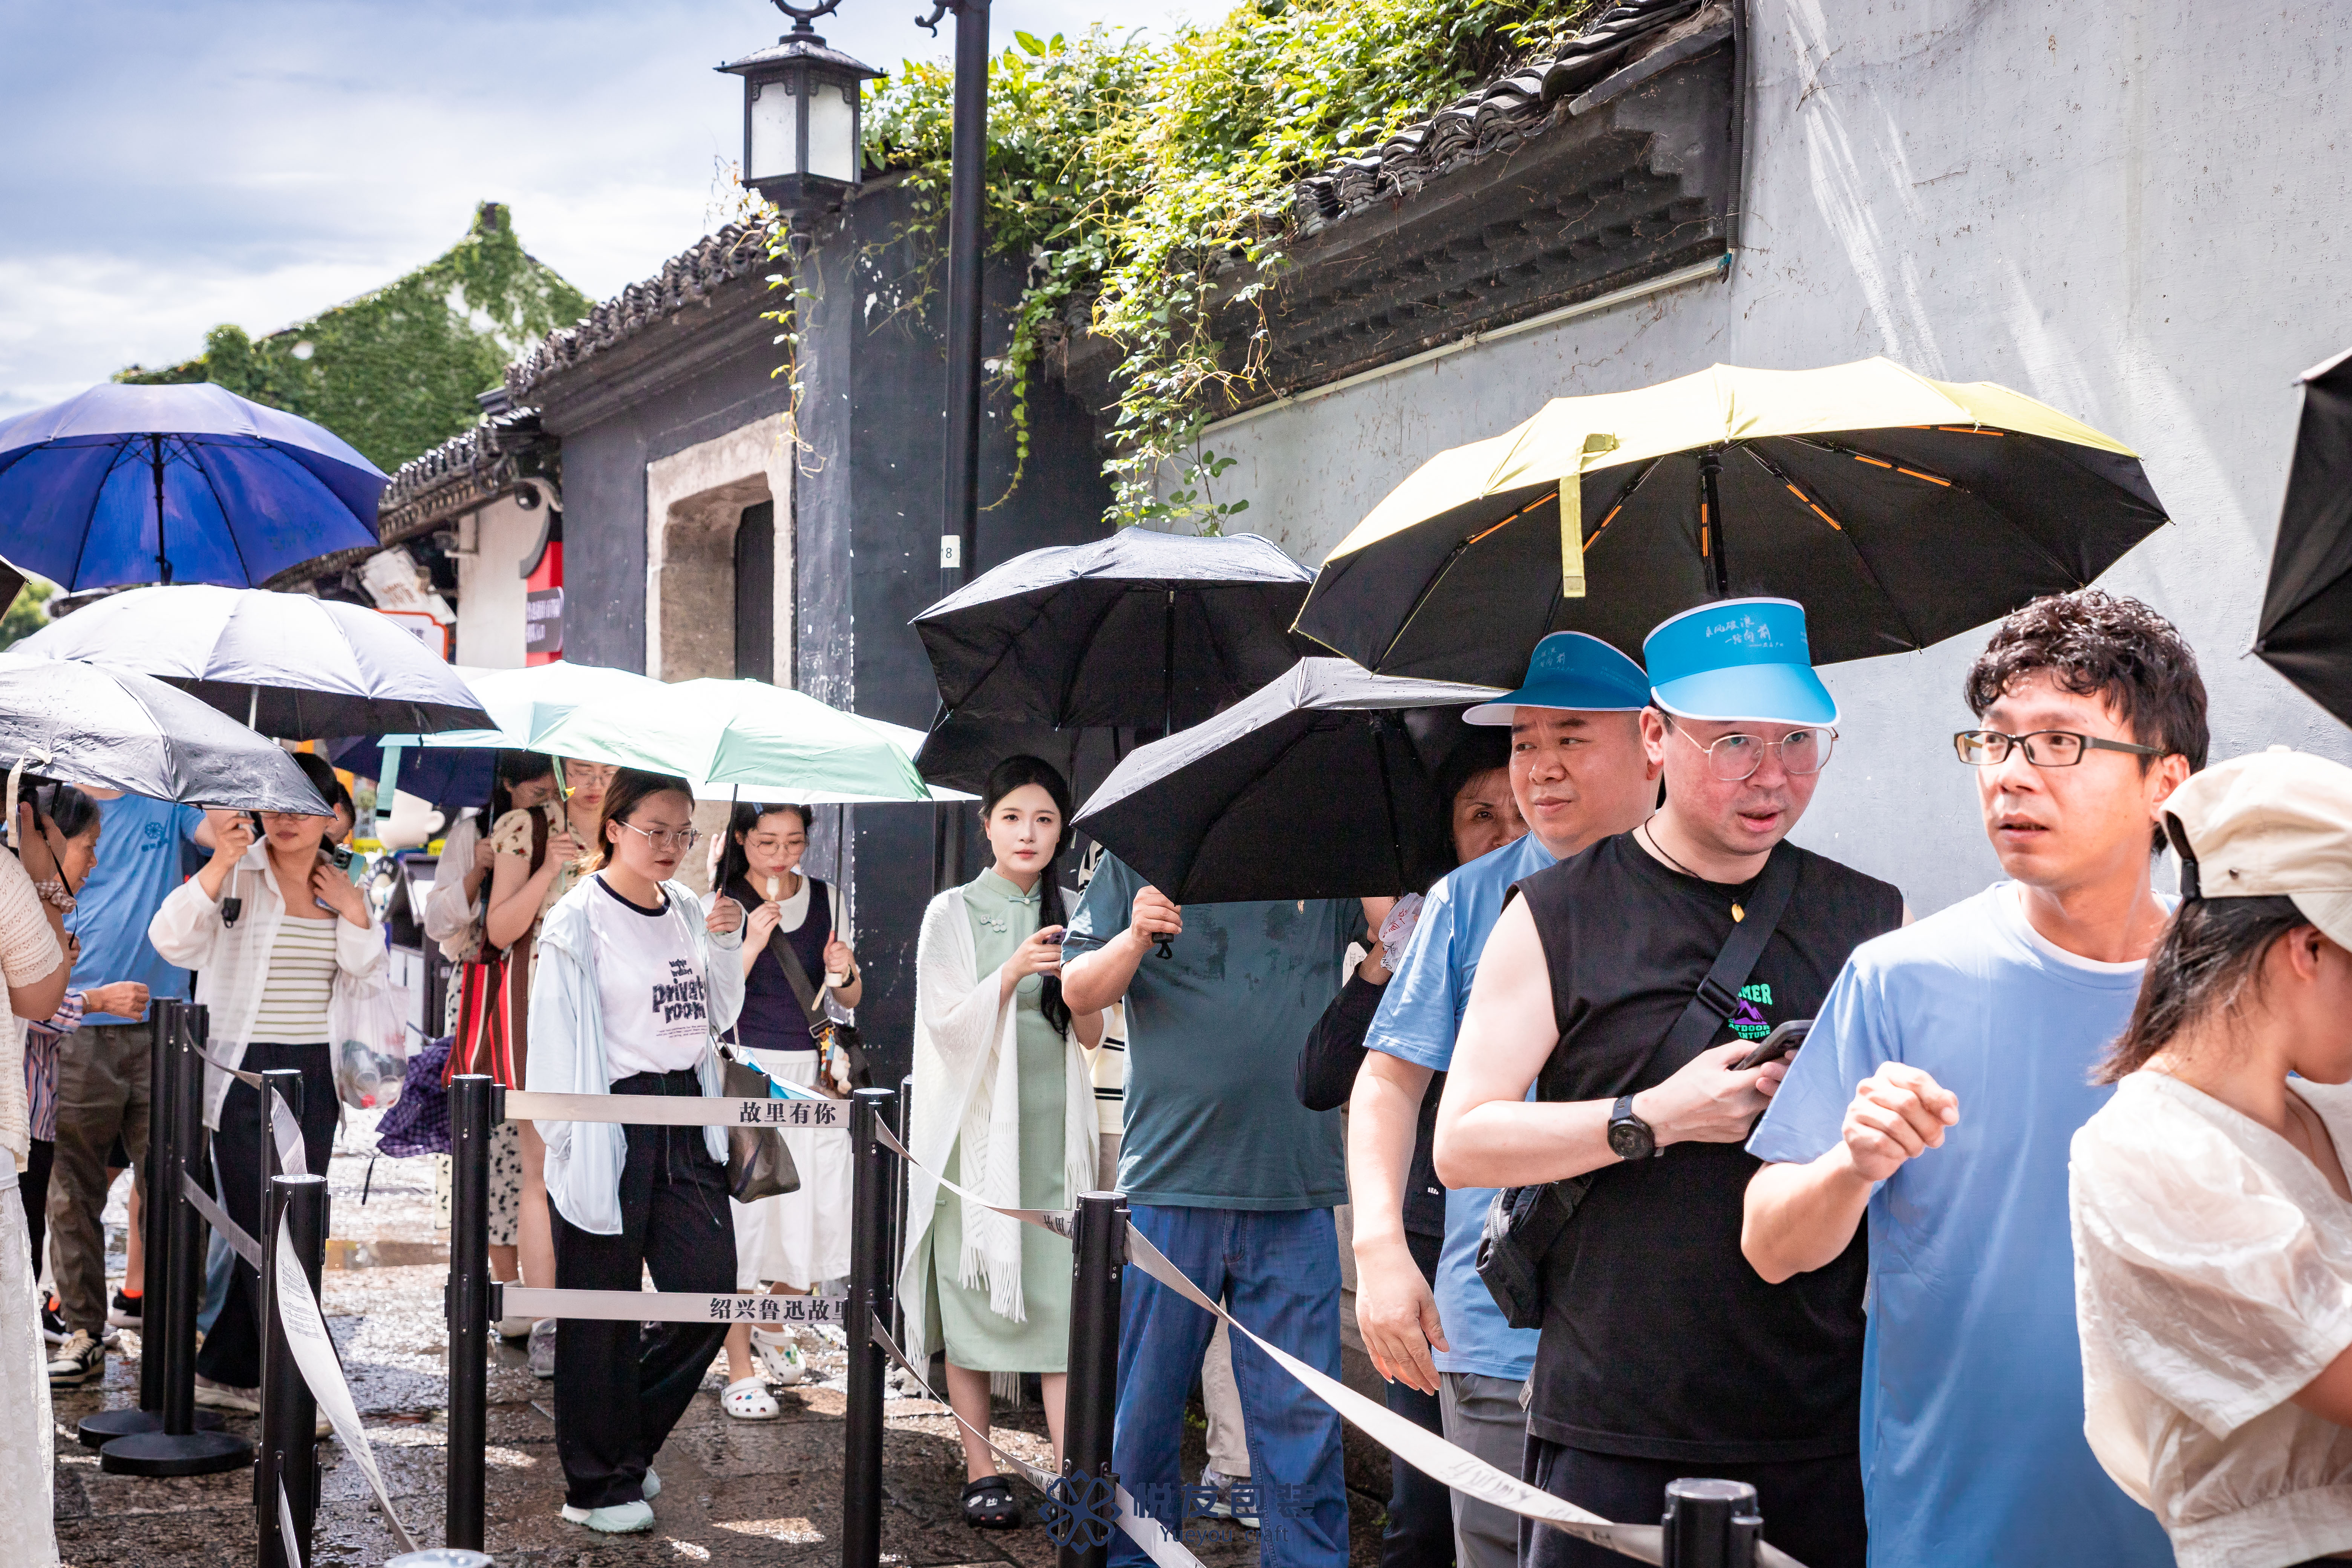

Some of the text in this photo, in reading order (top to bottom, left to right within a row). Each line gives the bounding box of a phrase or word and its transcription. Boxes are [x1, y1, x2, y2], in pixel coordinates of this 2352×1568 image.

[946, 548, 952, 558] 8
[1738, 983, 1773, 1005] MER
[664, 1001, 706, 1024] room
[739, 1101, 836, 1124] 故里有你
